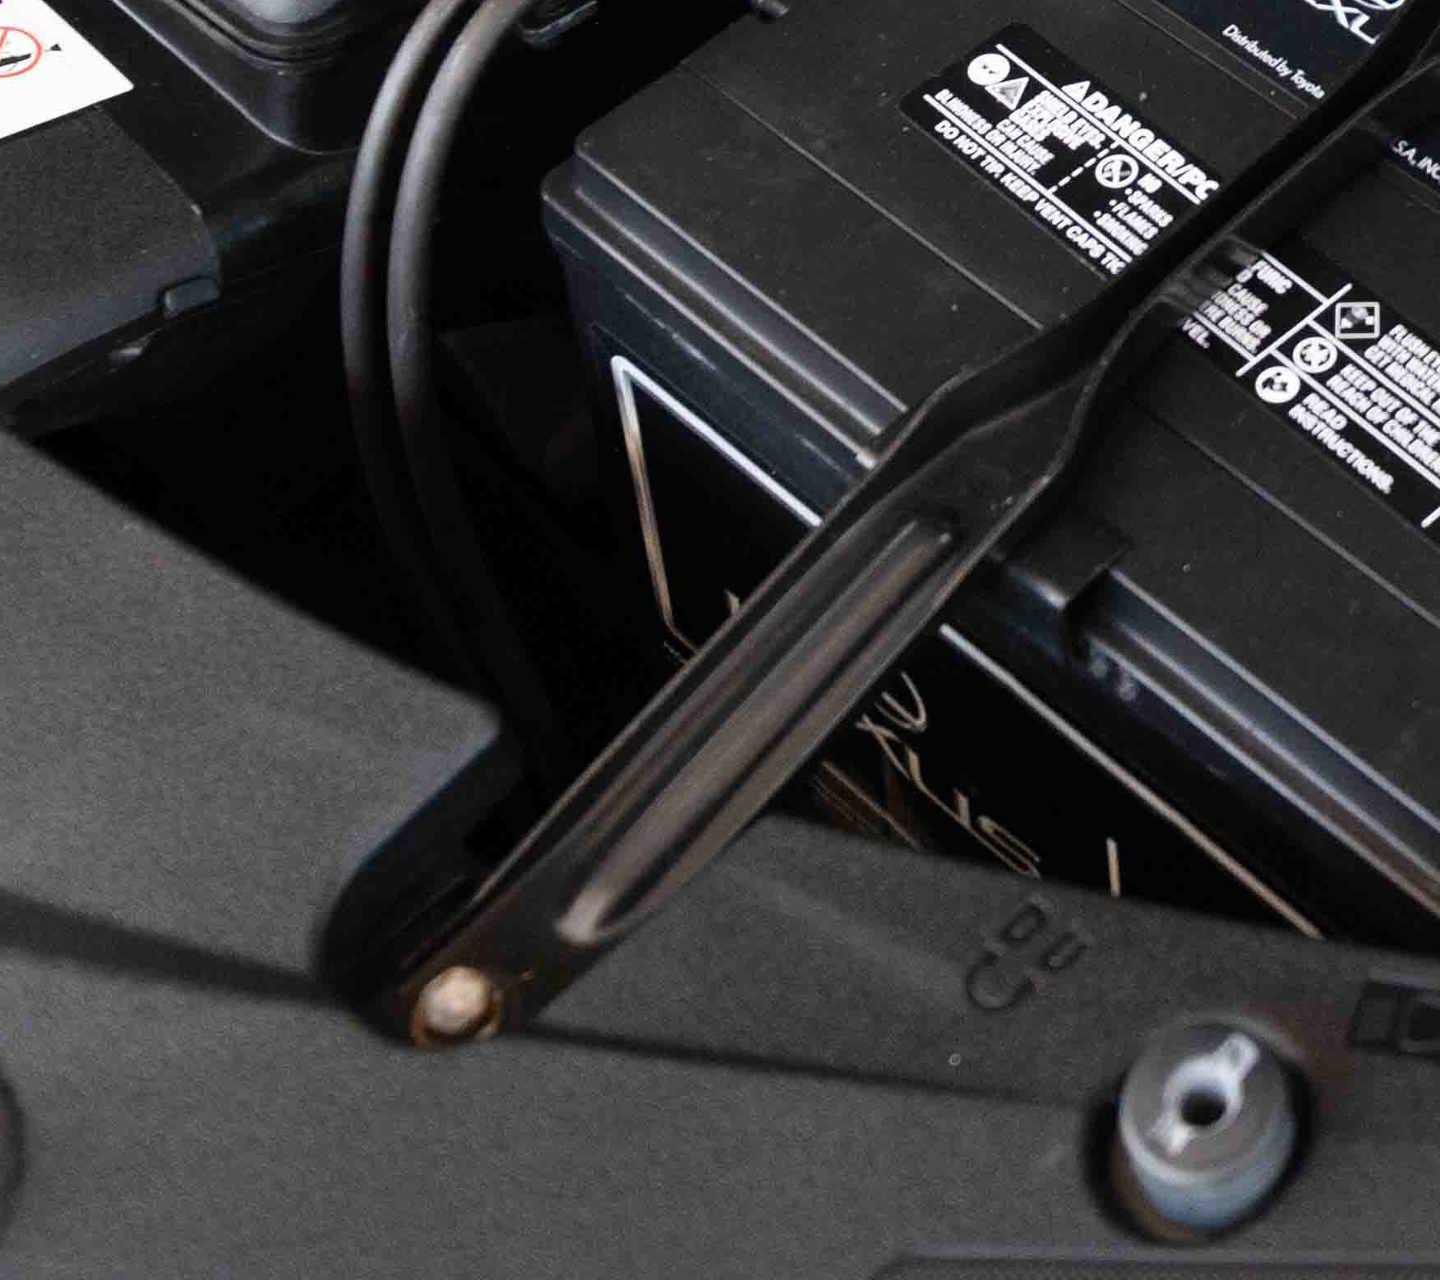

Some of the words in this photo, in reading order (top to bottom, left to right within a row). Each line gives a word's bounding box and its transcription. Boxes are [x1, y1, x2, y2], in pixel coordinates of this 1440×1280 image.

[1222, 24, 1283, 68] Distributed
[1276, 59, 1292, 76] by
[1290, 69, 1325, 99] Toyota
[935, 120, 959, 139] DO
[954, 135, 986, 159] NOT
[1001, 172, 1039, 201] KEEP
[1035, 199, 1073, 229] VENT
[1066, 225, 1105, 258] CAPS
[1303, 393, 1347, 430] READ
[1327, 375, 1372, 413] REACH
[1366, 406, 1389, 424] OF
[1340, 364, 1377, 390] KEEP
[1370, 388, 1401, 412] OUT
[1395, 407, 1418, 425] OF
